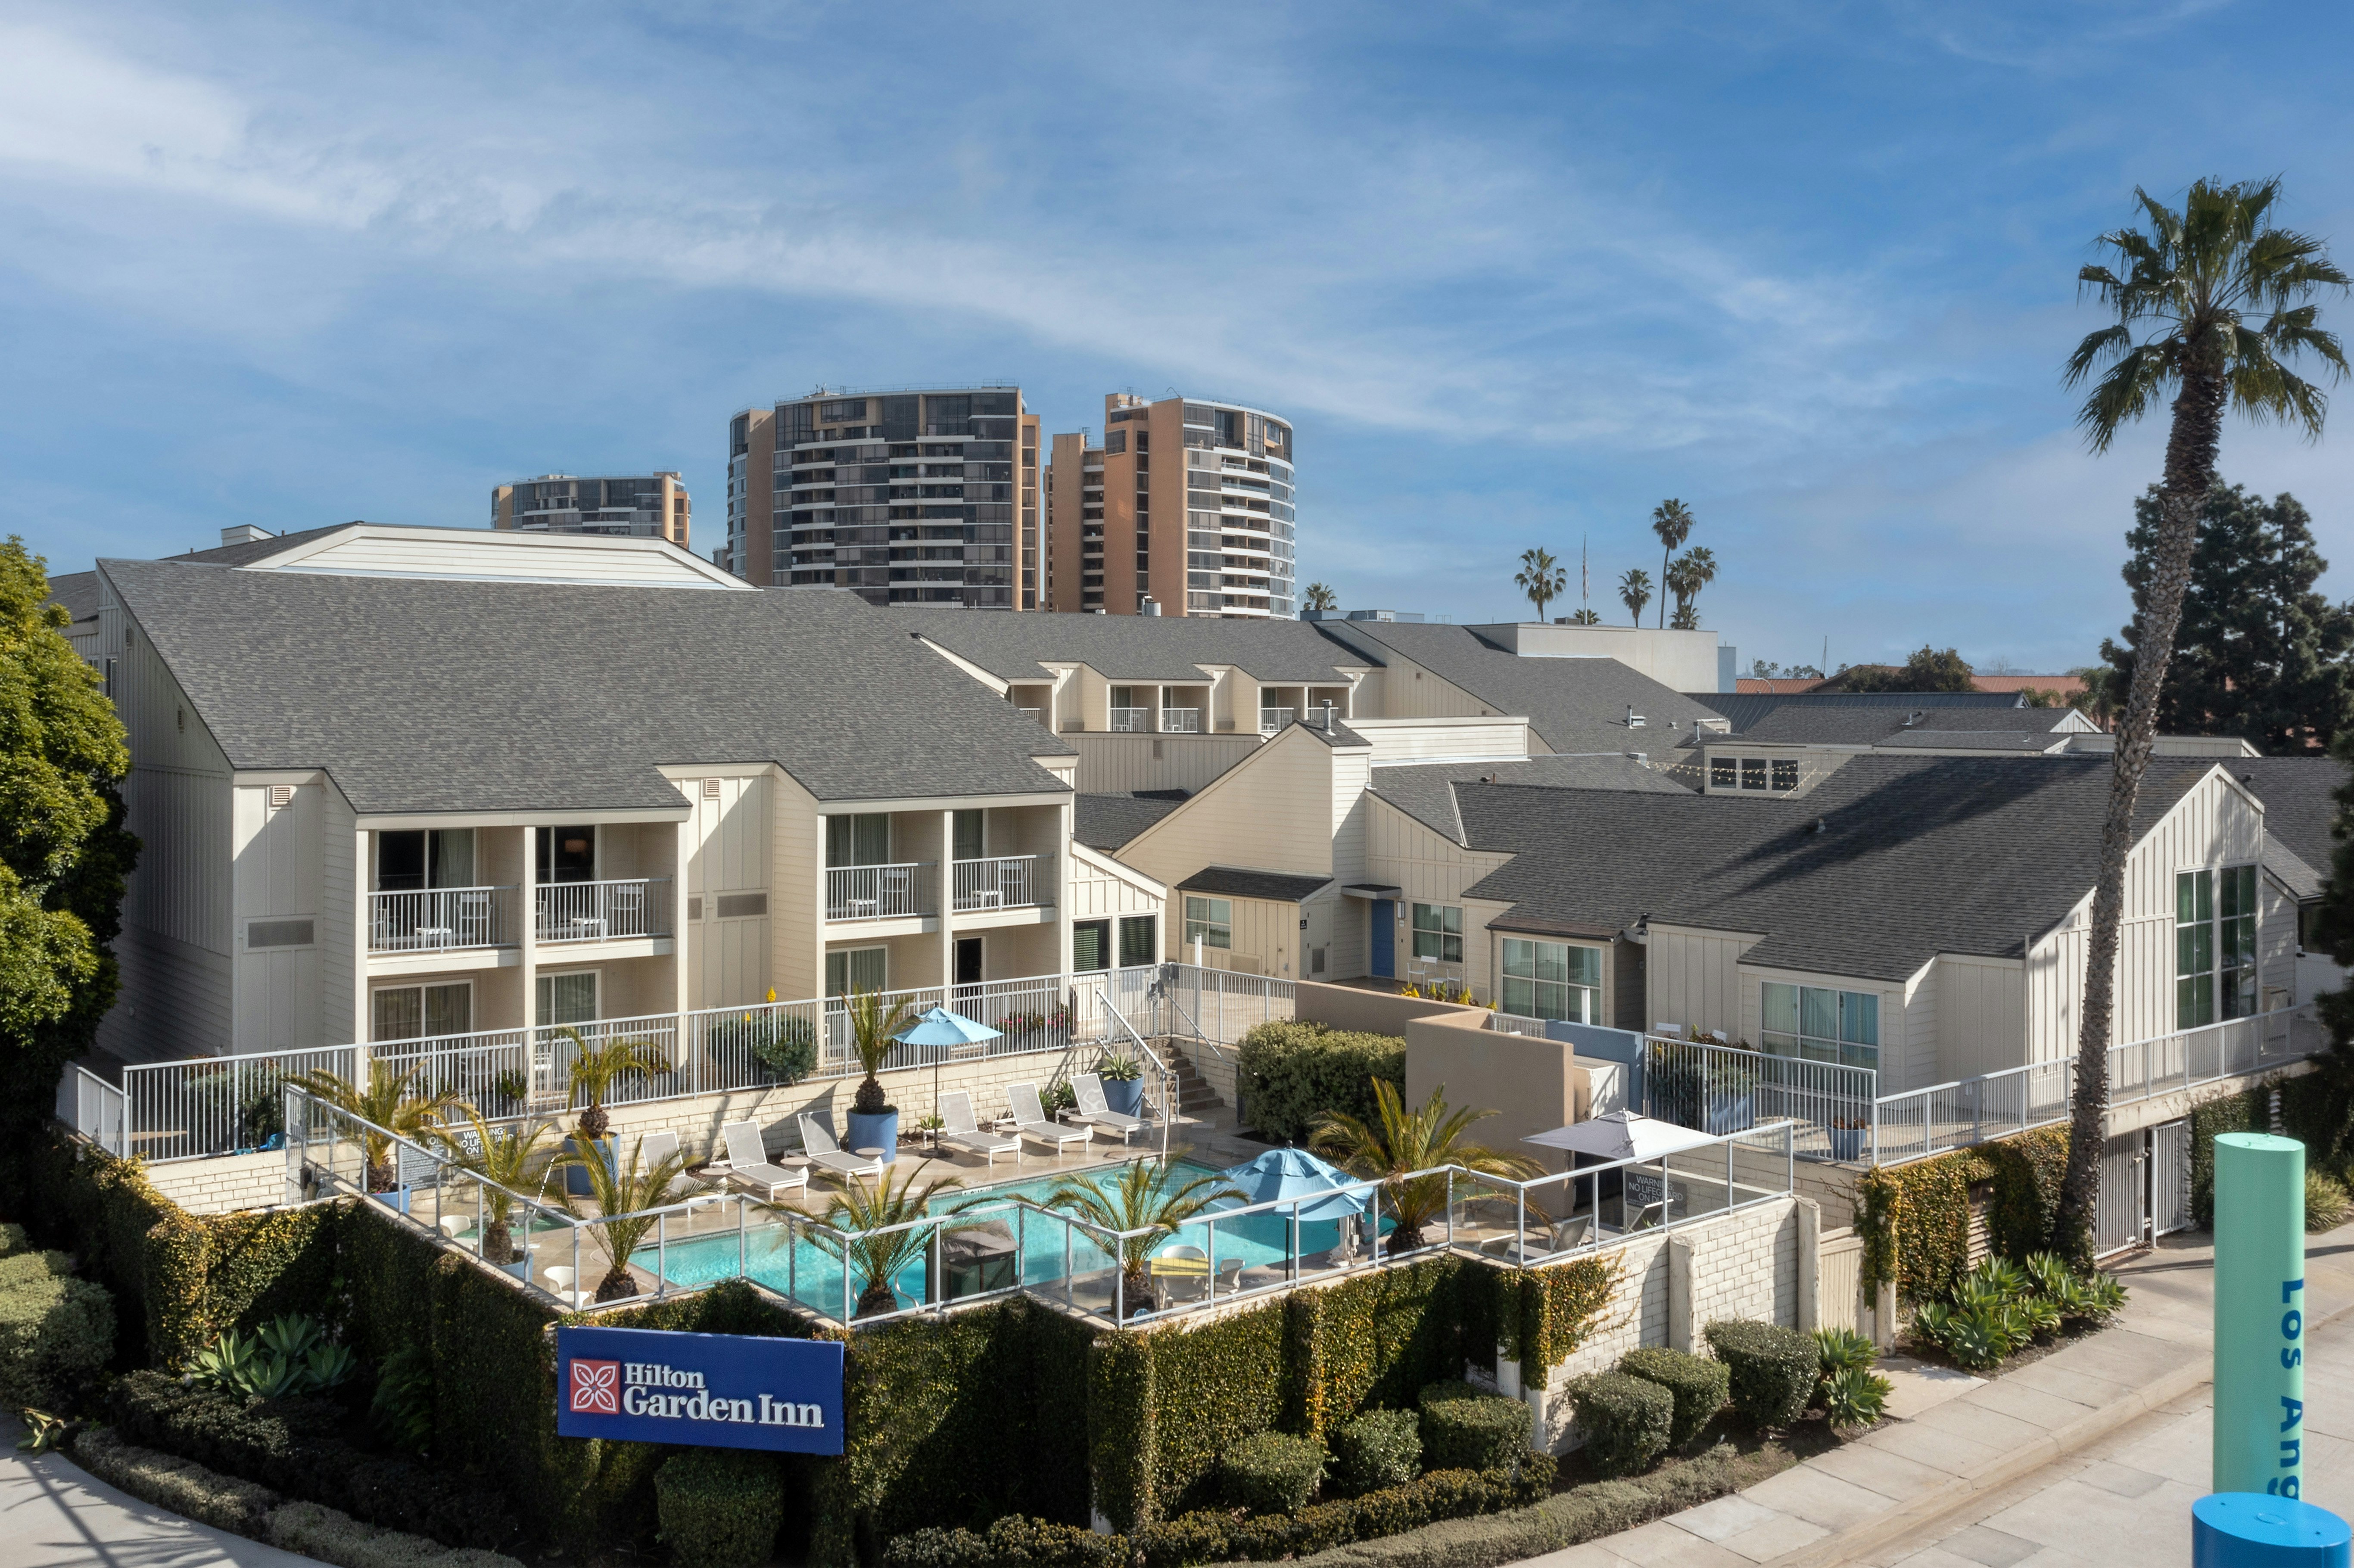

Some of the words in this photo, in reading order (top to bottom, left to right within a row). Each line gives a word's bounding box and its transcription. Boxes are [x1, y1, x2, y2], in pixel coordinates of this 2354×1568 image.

[466, 1146, 479, 1155] ON
[1629, 1182, 1640, 1192] NO
[1641, 1185, 1683, 1201] LIFEGARD
[1636, 1175, 1675, 1191] WARNIG:
[1638, 1192, 1650, 1202] ON
[2281, 1278, 2304, 1369] Los
[624, 1363, 705, 1389] Hilton
[623, 1385, 755, 1423] Garden
[758, 1394, 825, 1428] Inn
